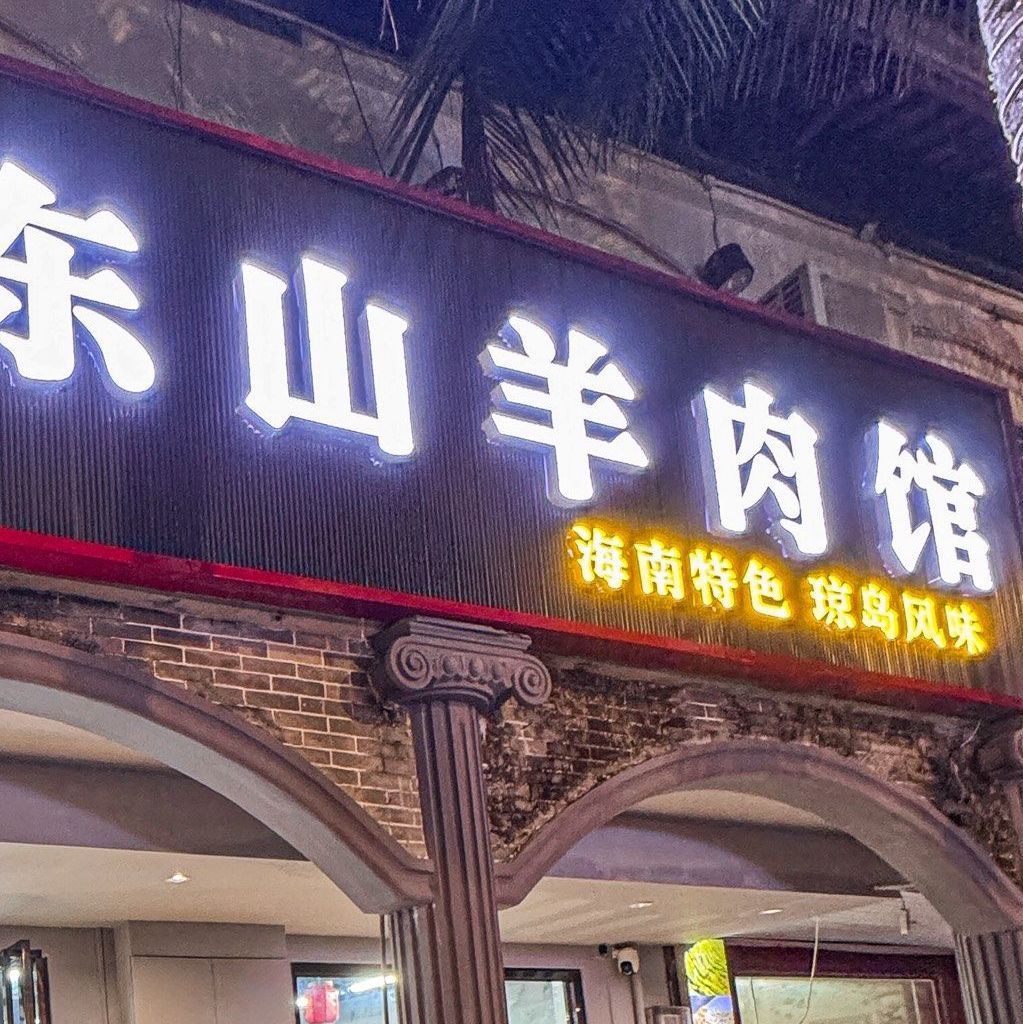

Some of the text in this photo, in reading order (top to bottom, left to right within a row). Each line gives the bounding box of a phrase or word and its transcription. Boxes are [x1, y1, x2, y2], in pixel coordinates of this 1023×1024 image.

[572, 523, 989, 657] 海南特色 琼岛风味
